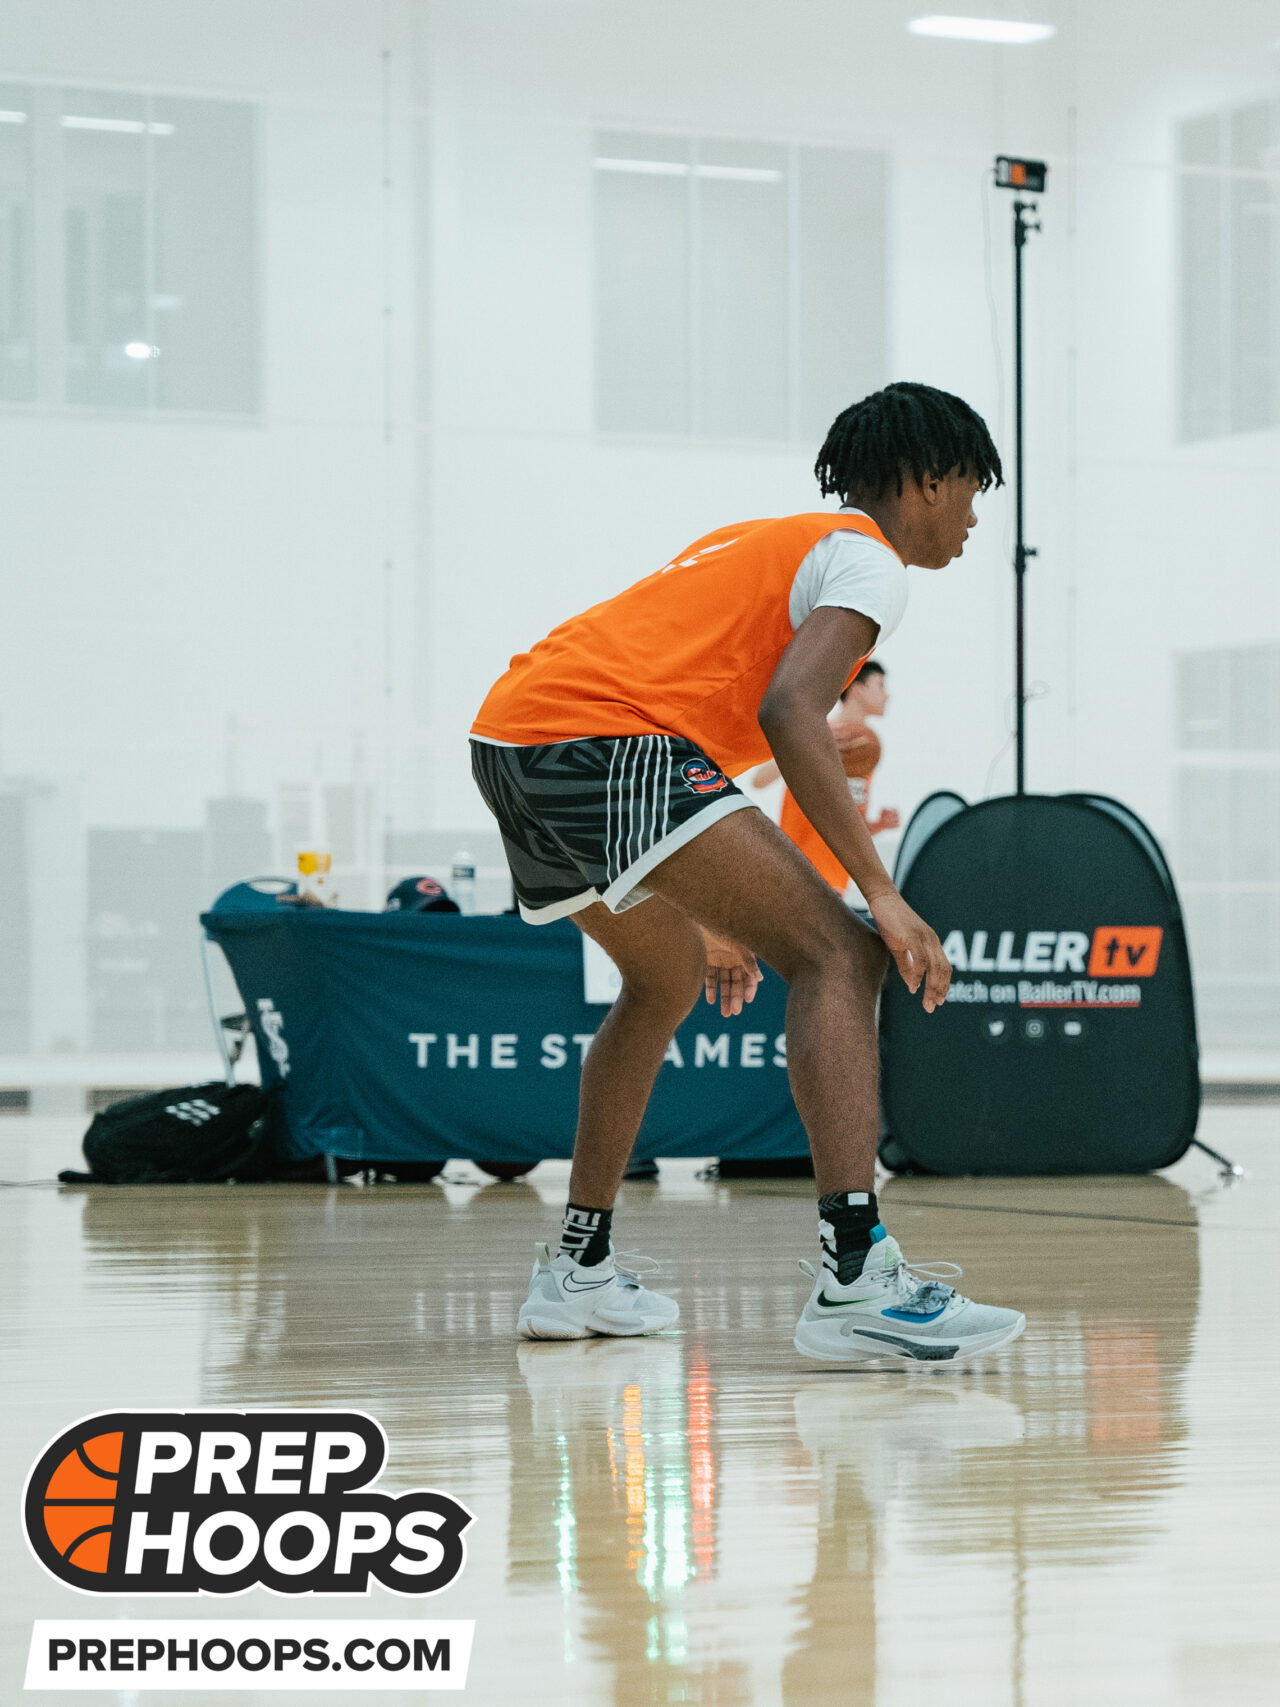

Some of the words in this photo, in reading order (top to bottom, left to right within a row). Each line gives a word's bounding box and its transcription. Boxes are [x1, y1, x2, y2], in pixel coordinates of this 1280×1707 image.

[941, 929, 1090, 973] ALLER
[1105, 937, 1147, 967] tv
[946, 980, 988, 1003] atch
[989, 983, 1016, 1004] on
[1018, 979, 1142, 1004] BallerTV.com
[408, 1032, 519, 1069] THE
[663, 1033, 788, 1069] AMES
